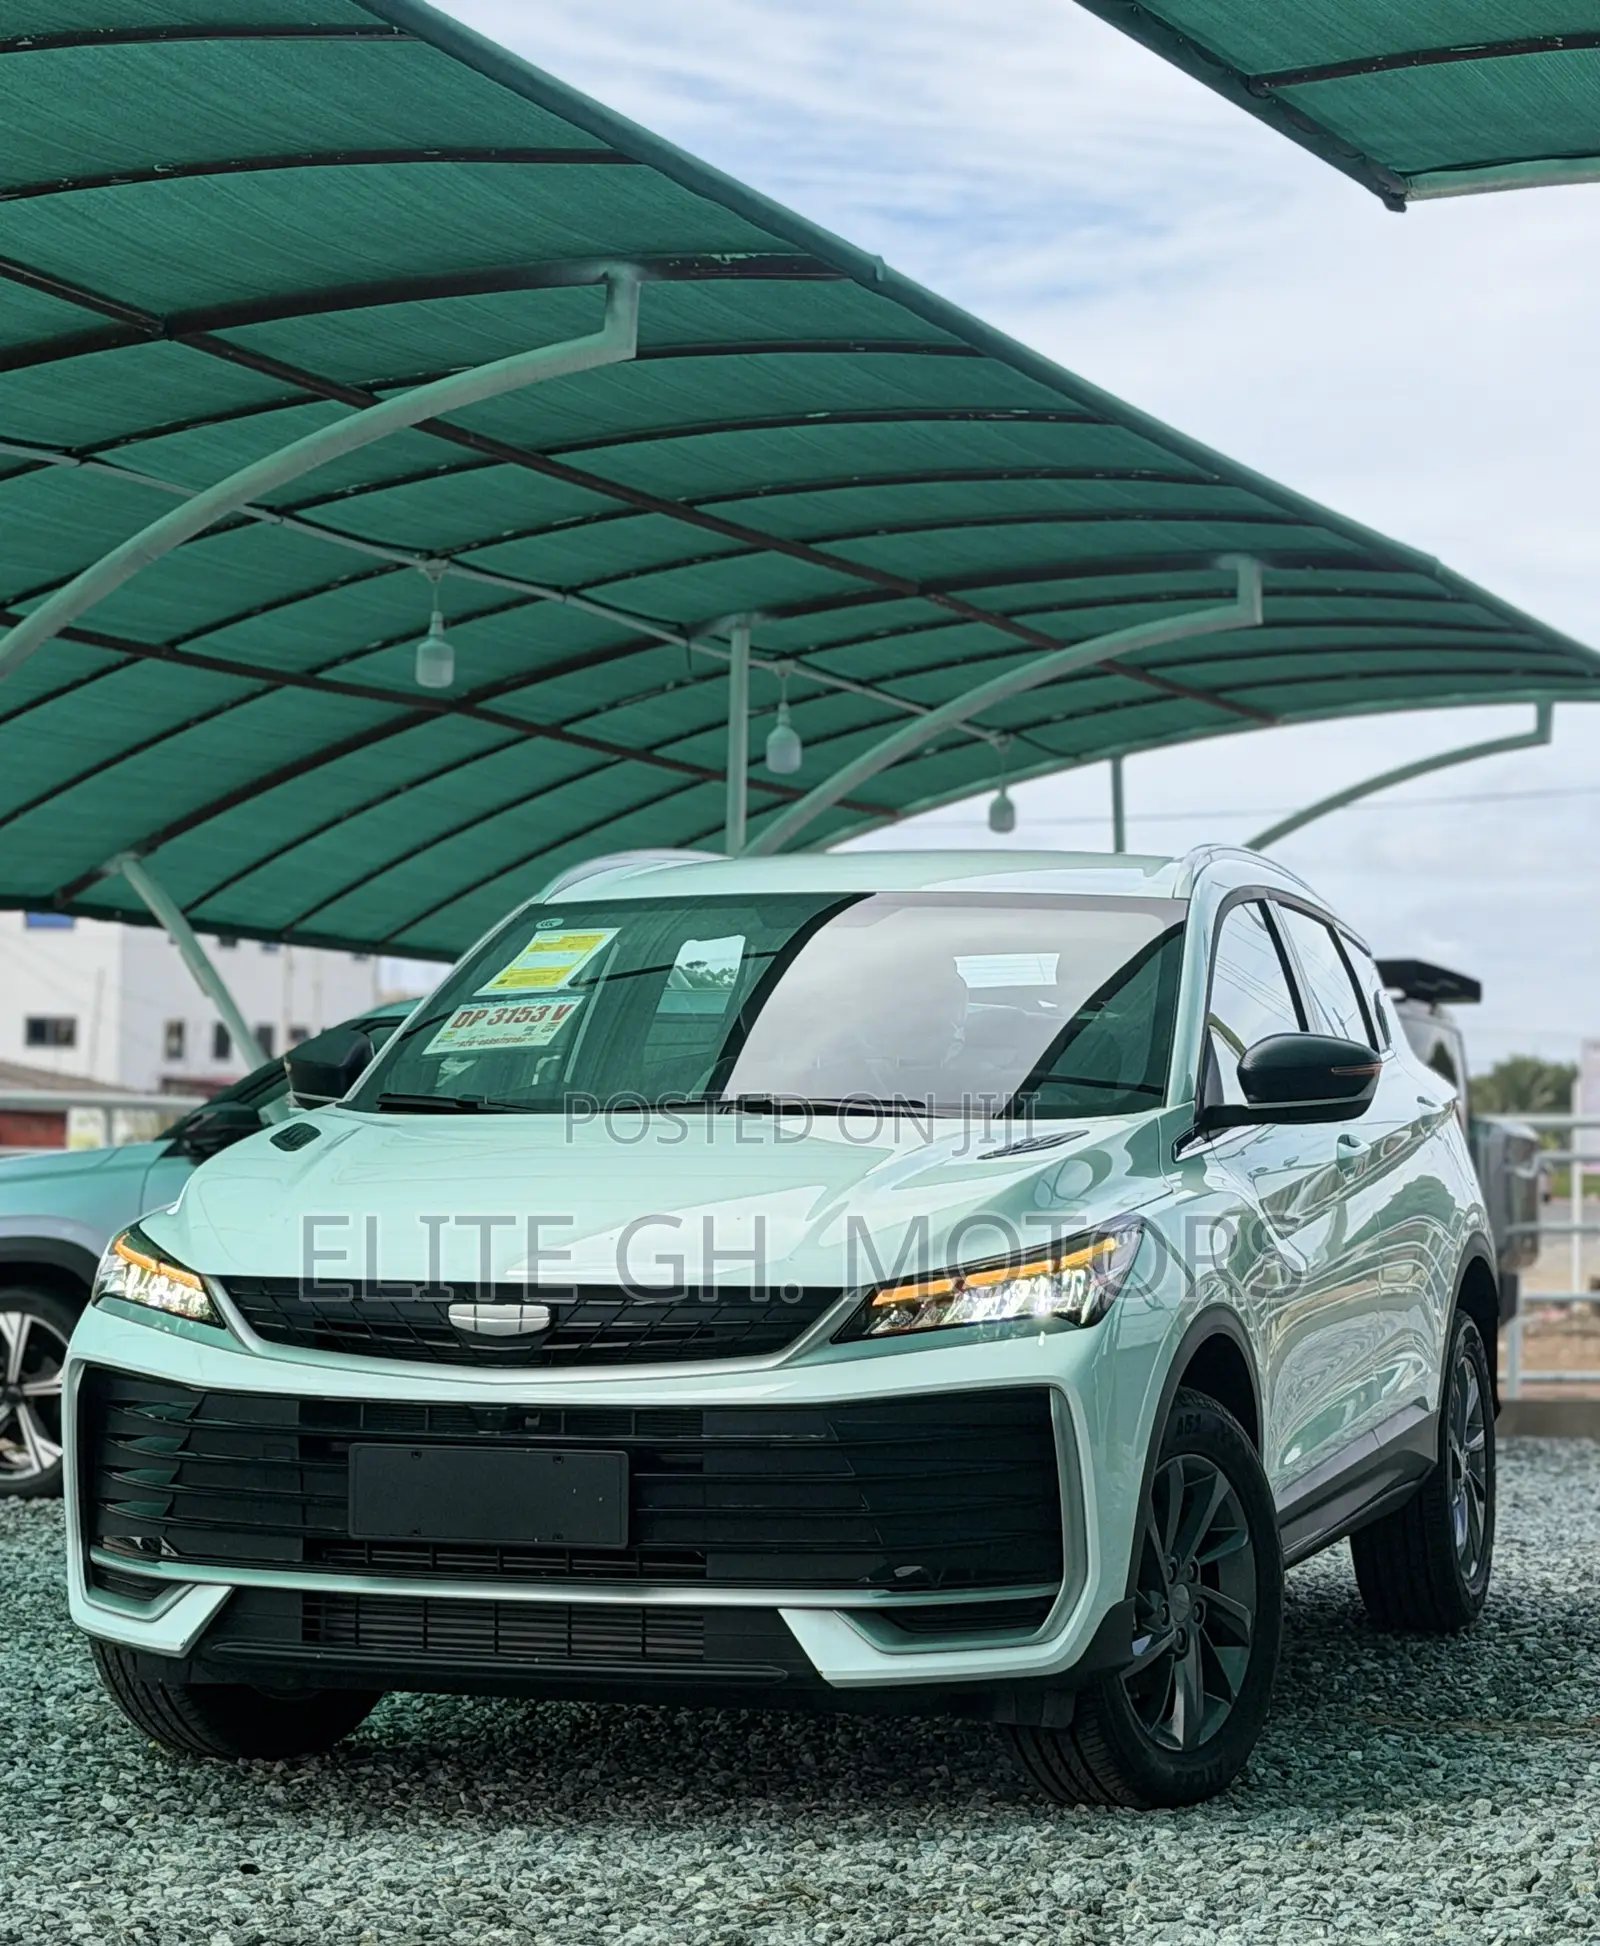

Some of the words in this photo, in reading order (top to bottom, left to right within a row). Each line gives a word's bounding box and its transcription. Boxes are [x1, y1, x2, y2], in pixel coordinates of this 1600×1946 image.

[450, 1010, 488, 1029] DP
[487, 1005, 552, 1026] 3153
[552, 1004, 574, 1021] V
